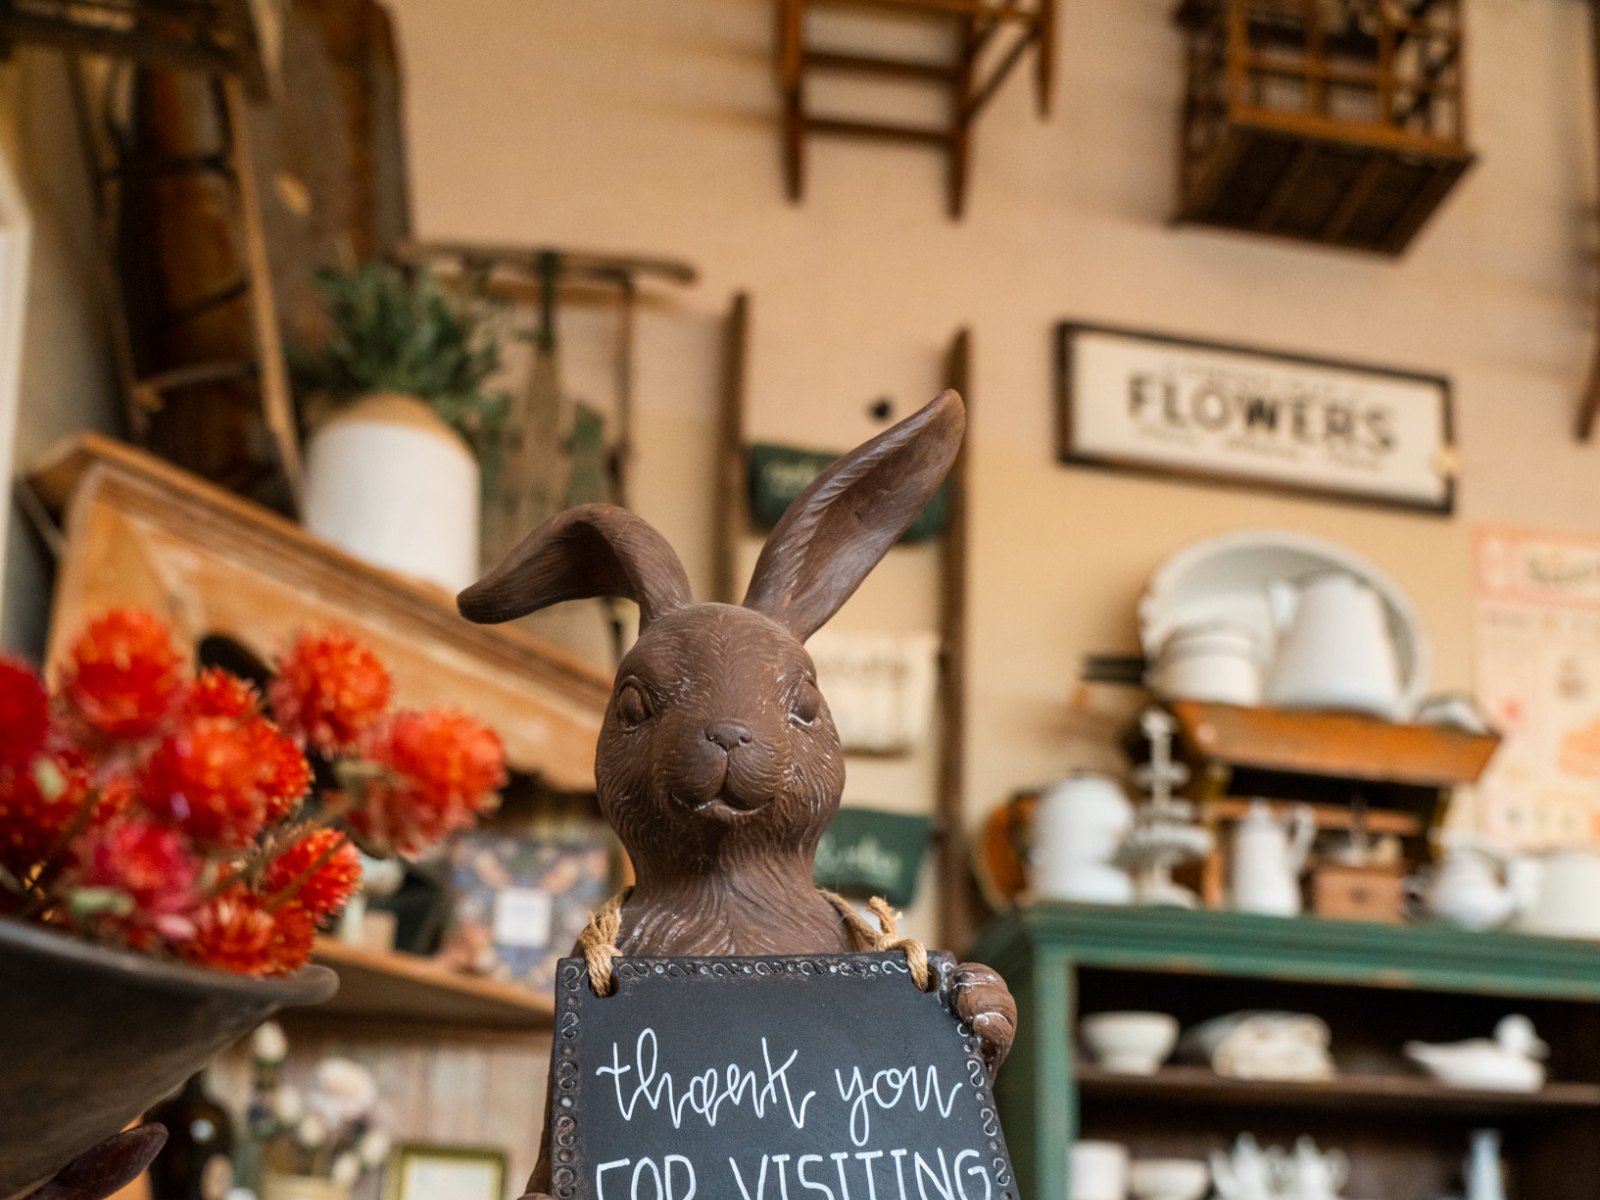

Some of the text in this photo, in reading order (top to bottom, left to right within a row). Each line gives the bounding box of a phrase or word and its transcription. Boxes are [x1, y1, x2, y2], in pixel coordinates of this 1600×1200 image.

[1127, 372, 1396, 454] FLOWERS
[596, 1028, 963, 1147] thank you
